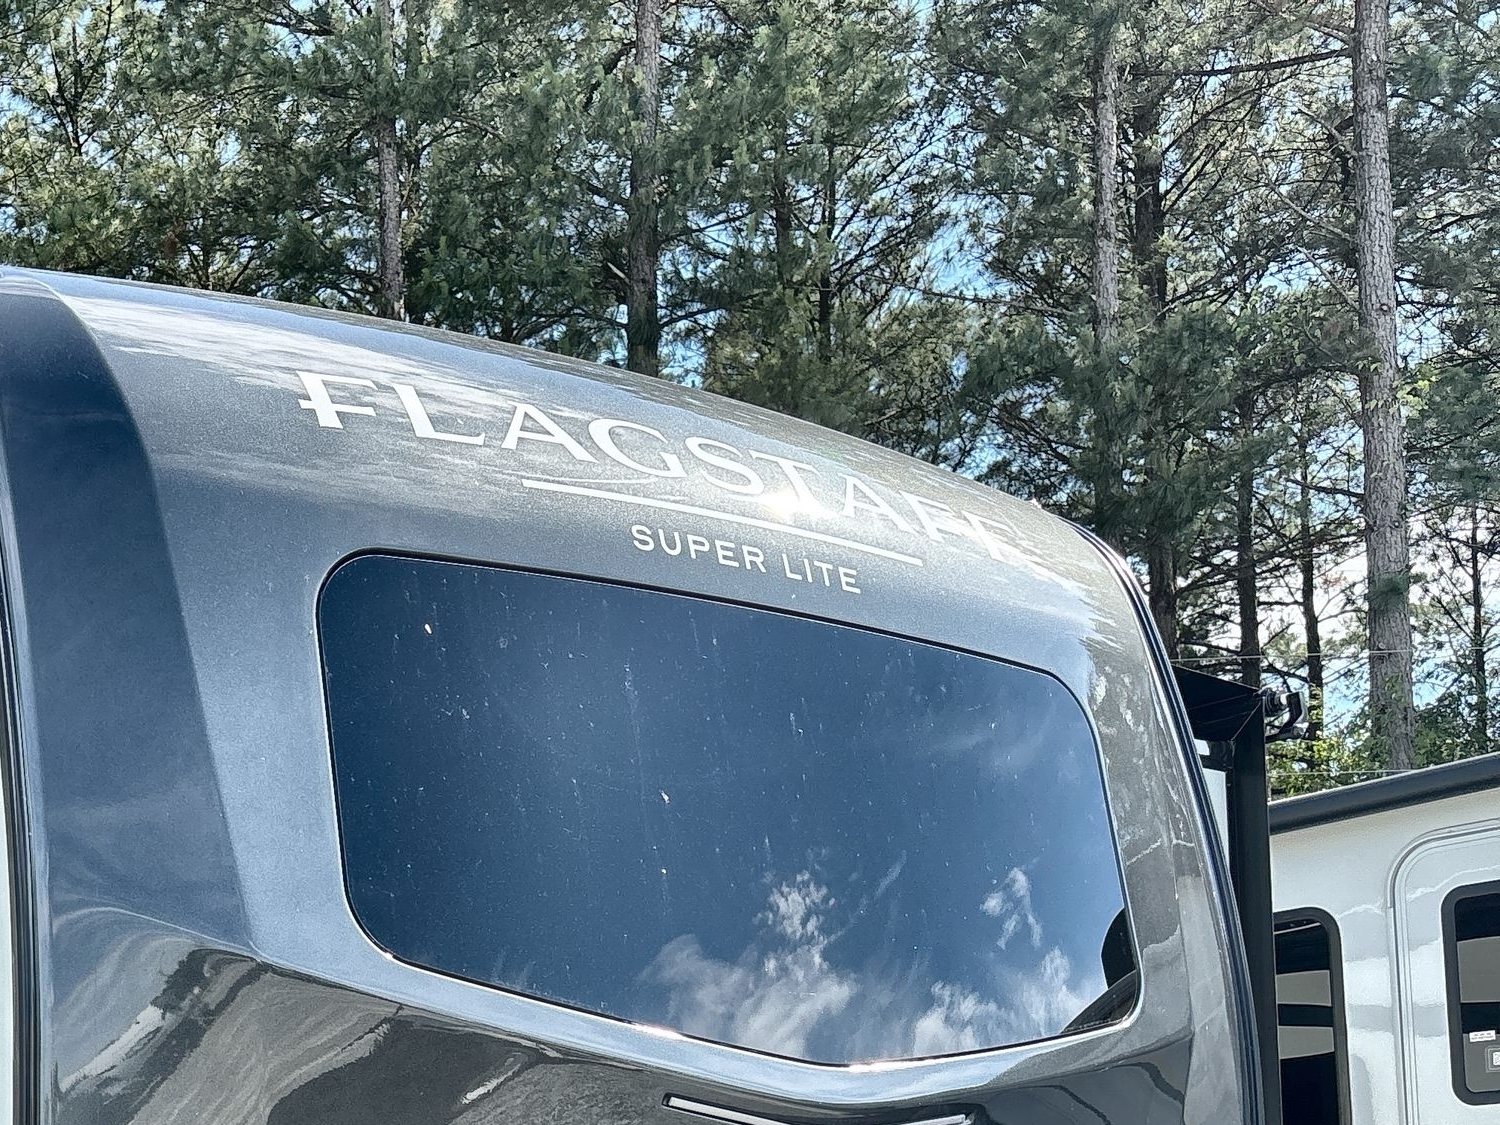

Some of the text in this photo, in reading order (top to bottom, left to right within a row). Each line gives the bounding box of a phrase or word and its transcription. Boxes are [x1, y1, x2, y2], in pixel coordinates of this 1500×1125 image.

[296, 370, 1018, 562] FLAGSTAFF
[630, 524, 862, 594] SUPER LITE
